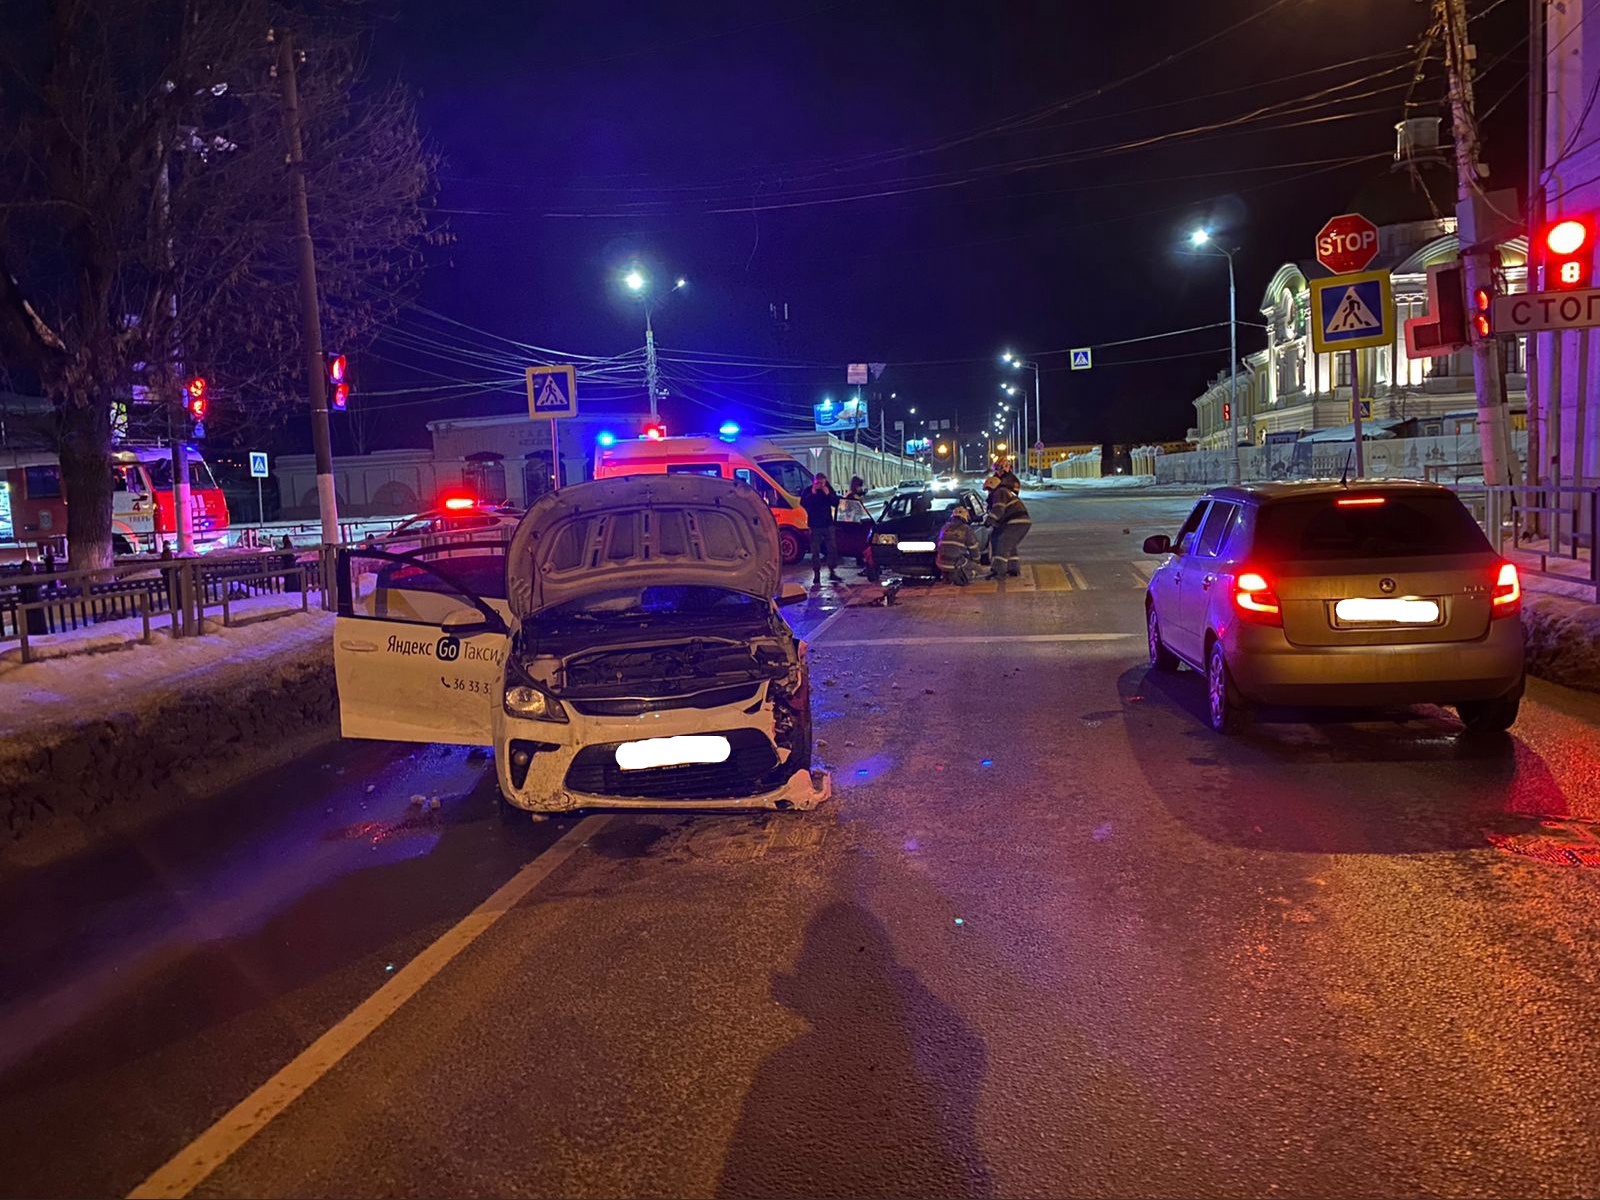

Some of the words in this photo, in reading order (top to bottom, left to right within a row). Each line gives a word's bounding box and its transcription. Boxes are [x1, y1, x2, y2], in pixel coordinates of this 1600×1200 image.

[1319, 230, 1376, 257] STOP
[132, 502, 141, 511] 4
[387, 635, 433, 656] Яндекс
[439, 639, 457, 659] Go
[463, 641, 498, 662] Такси
[453, 679, 465, 691] 36
[468, 680, 480, 693] 33
